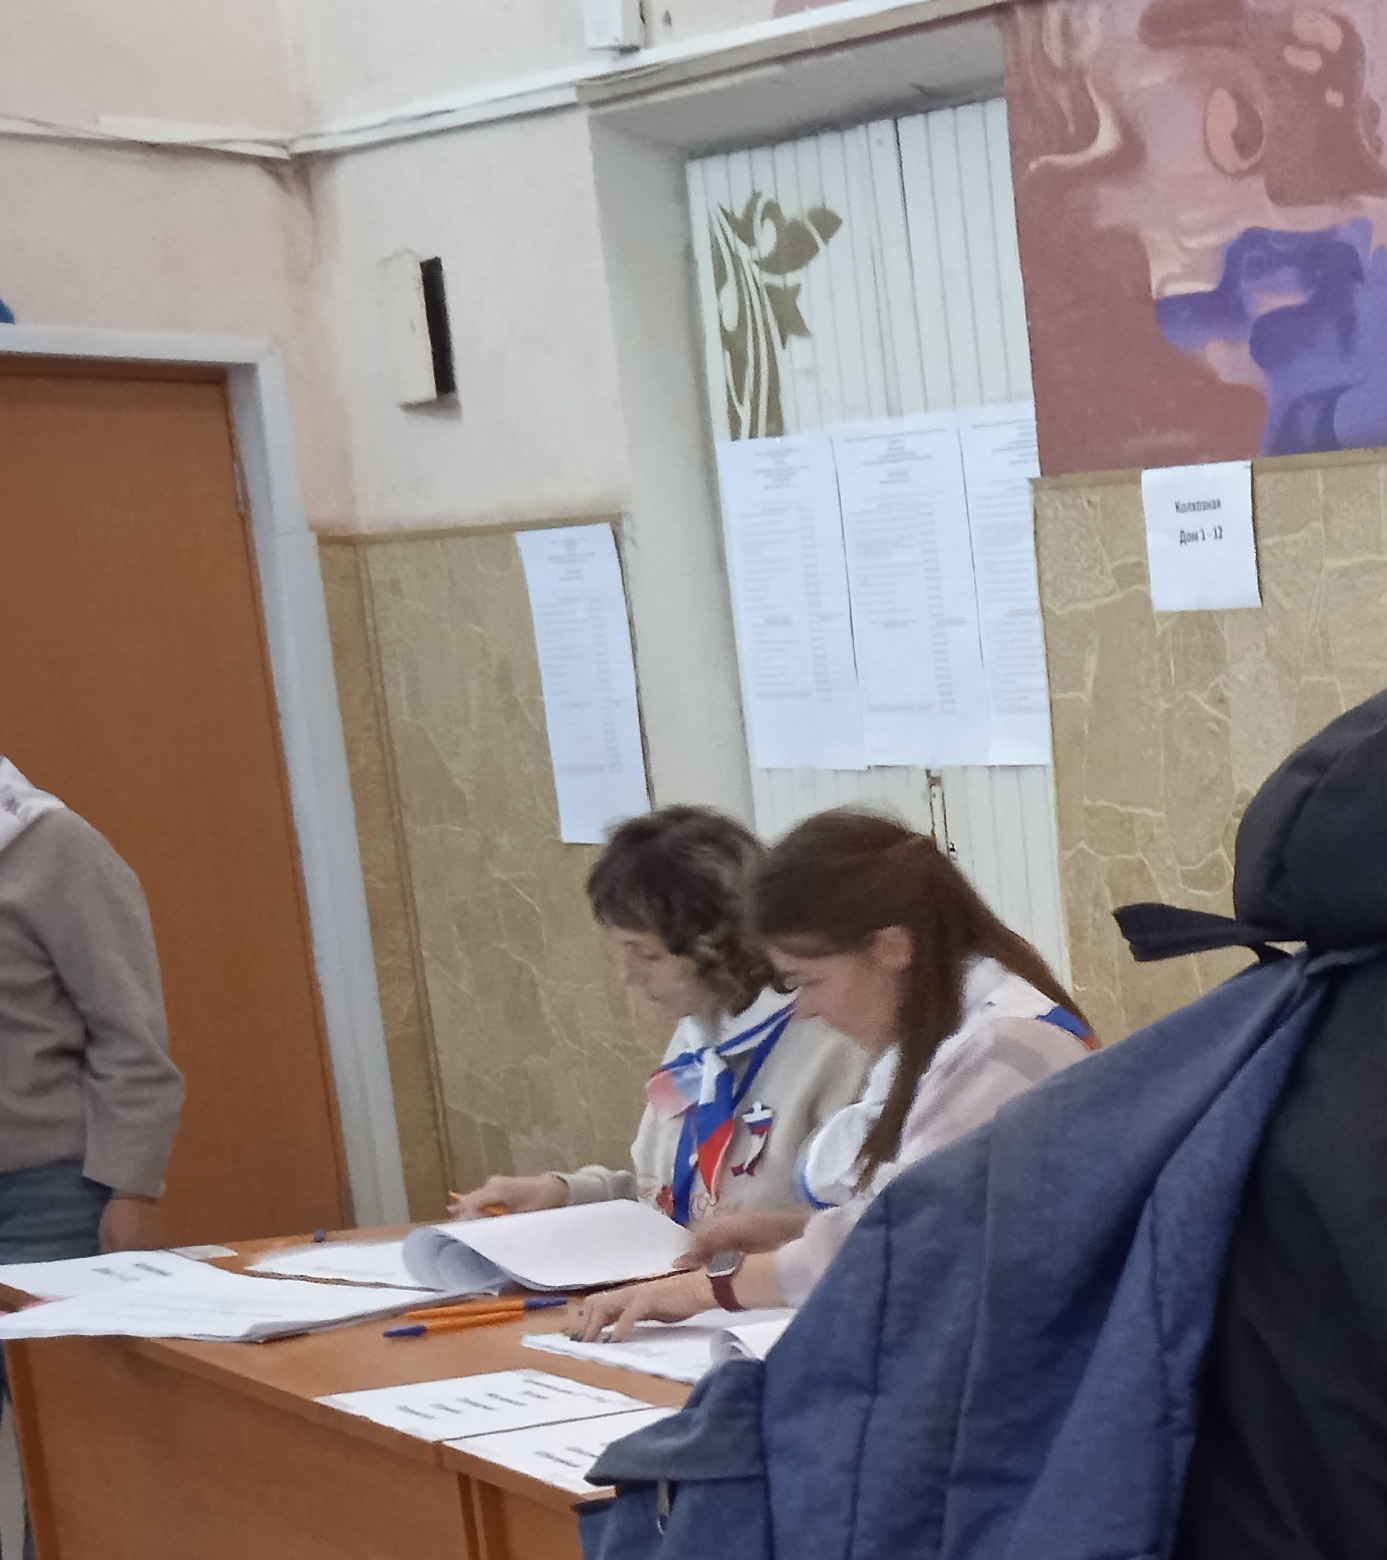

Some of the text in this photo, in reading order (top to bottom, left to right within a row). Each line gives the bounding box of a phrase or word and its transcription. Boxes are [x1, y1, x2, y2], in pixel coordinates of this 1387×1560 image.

[1175, 498, 1221, 514] Колхозная
[1180, 529, 1199, 547] Дом
[1213, 525, 1223, 540] 12
